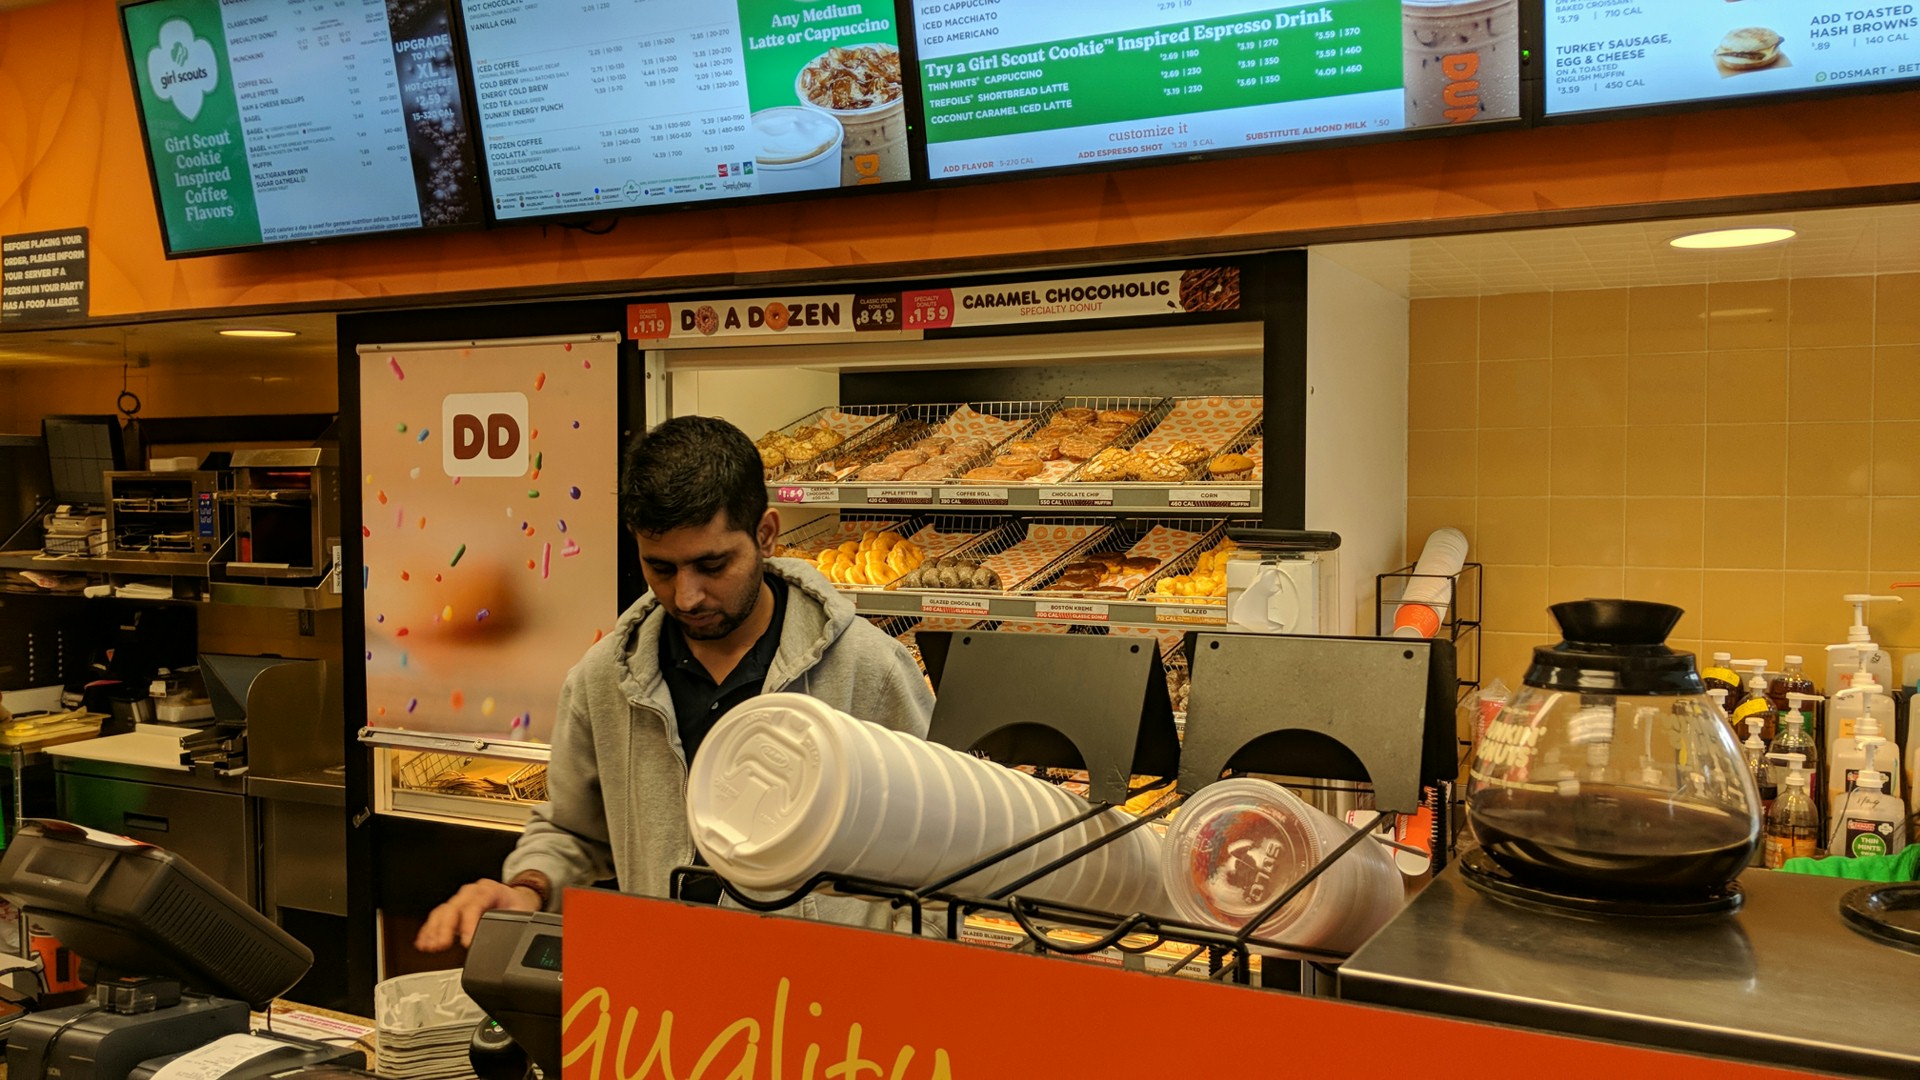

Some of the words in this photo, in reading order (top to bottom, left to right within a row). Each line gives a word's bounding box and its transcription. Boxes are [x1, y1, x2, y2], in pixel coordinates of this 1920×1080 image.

[772, 12, 800, 28] Any
[802, 3, 862, 23] Medium
[921, 5, 941, 16] ICED
[1605, 9, 1621, 18] 710
[1623, 7, 1643, 16] CAL
[1810, 13, 1841, 26] ADD
[1845, 4, 1913, 21] TOASTED
[470, 22, 499, 31] VANILLA
[500, 18, 517, 26] CHAI
[923, 20, 943, 30] ICED
[945, 12, 998, 27] MACCHIATO
[1810, 25, 1848, 39] HASH
[1852, 17, 1918, 34] BROWNS
[749, 35, 784, 50] Latte
[787, 32, 802, 44] or
[804, 18, 890, 42] Cappuccino
[924, 35, 944, 46] ICED
[946, 27, 999, 42] AMERICANO
[1344, 27, 1360, 36] 370
[1866, 35, 1884, 45] 140
[1887, 33, 1909, 42] CAL
[395, 34, 449, 53] UPGRADE
[925, 62, 954, 78] Try
[956, 62, 966, 73] a
[968, 54, 999, 72] Girl
[1001, 48, 1046, 67] Scout
[1117, 27, 1190, 51] Inspired
[1193, 18, 1272, 41] Espresso
[1275, 7, 1333, 30] Drink
[1556, 41, 1604, 55] TURKEY
[1608, 33, 1672, 50] SAUSAGE,
[411, 53, 422, 61] TO
[424, 50, 436, 58] AN
[1556, 56, 1581, 68] EGG
[1585, 55, 1593, 65] &
[1596, 48, 1645, 63] CHEESE
[416, 62, 439, 79] XL
[477, 65, 492, 74] ICED
[494, 60, 520, 71] COFFEE
[1556, 68, 1569, 76] ON
[1571, 67, 1577, 75] A
[1579, 63, 1618, 73] TOASTED
[1830, 66, 1887, 80] DDSMART
[161, 71, 176, 88] girl
[177, 66, 208, 83] scouts
[404, 83, 420, 92] HOT
[422, 77, 454, 89] COFFEE
[928, 82, 949, 92] THIN
[984, 69, 1043, 85] CAPPUCCINO
[1556, 73, 1591, 84] ENGLISH
[1593, 70, 1625, 80] MUFFIN
[1605, 81, 1623, 89] 450
[1625, 79, 1645, 88] CAL
[978, 86, 1038, 102] SHORTBREAD
[1040, 82, 1069, 95] LATTE
[438, 108, 455, 118] CAL
[513, 106, 539, 116] ENERGY
[540, 103, 564, 112] PUNCH
[931, 111, 973, 124] COCONUT
[975, 106, 1018, 119] CARAMEL
[1020, 103, 1042, 113] ICED
[1043, 99, 1073, 111] LATTE
[1109, 124, 1174, 142] customize
[1178, 122, 1188, 135] it
[1246, 127, 1300, 141] SUBSTITUTE
[1302, 123, 1342, 136] ALMOND
[1344, 120, 1367, 131] MILK
[165, 135, 191, 153] Girl
[193, 129, 231, 149] Scout
[489, 140, 516, 150] FROZEN
[517, 138, 543, 147] COFFEE
[1078, 150, 1096, 159] ADD
[1097, 145, 1139, 158] ESPRESSO
[1140, 143, 1163, 153] SHOT
[176, 152, 221, 173] Cookie
[493, 167, 520, 176] FROZEN
[521, 163, 562, 173] CHOCOLATE
[943, 164, 960, 174] ADD
[961, 160, 994, 171] FLAVOR
[174, 167, 231, 188] Inspired
[287, 168, 309, 176] BROWN
[256, 179, 274, 188] SUGAR
[275, 177, 300, 186] OATMEAL
[185, 188, 228, 205] Coffee
[185, 205, 234, 222] Flavors
[4, 240, 30, 251] BEFORE
[31, 237, 60, 249] PLACING
[62, 235, 82, 245] YOUR
[4, 256, 29, 266] ORDER,
[30, 253, 56, 263] PLEASE
[57, 250, 85, 260] INFORM
[4, 272, 23, 280] YOUR
[25, 268, 51, 279] SERVER
[52, 268, 59, 276] IF
[60, 267, 66, 275] A
[3, 285, 31, 295] PERSON
[32, 285, 39, 293] IN
[40, 282, 60, 292] YOUR
[61, 281, 84, 291] PARTY
[962, 290, 1041, 310] CARAMEL
[1045, 280, 1170, 304] CHOCOHOLIC
[3, 301, 18, 310] HAS
[19, 301, 24, 309] A
[26, 300, 45, 309] FOOD
[46, 297, 79, 307] ALLERGY.
[1020, 304, 1067, 317] SPECIALTY
[1069, 301, 1104, 313] DONUT
[724, 306, 741, 329] A
[453, 413, 521, 460] DD
[1858, 844, 1881, 852] MINTS
[1861, 836, 1879, 845] THIN
[962, 930, 984, 938] GLAZED
[984, 933, 1015, 942] BLUEBERRY
